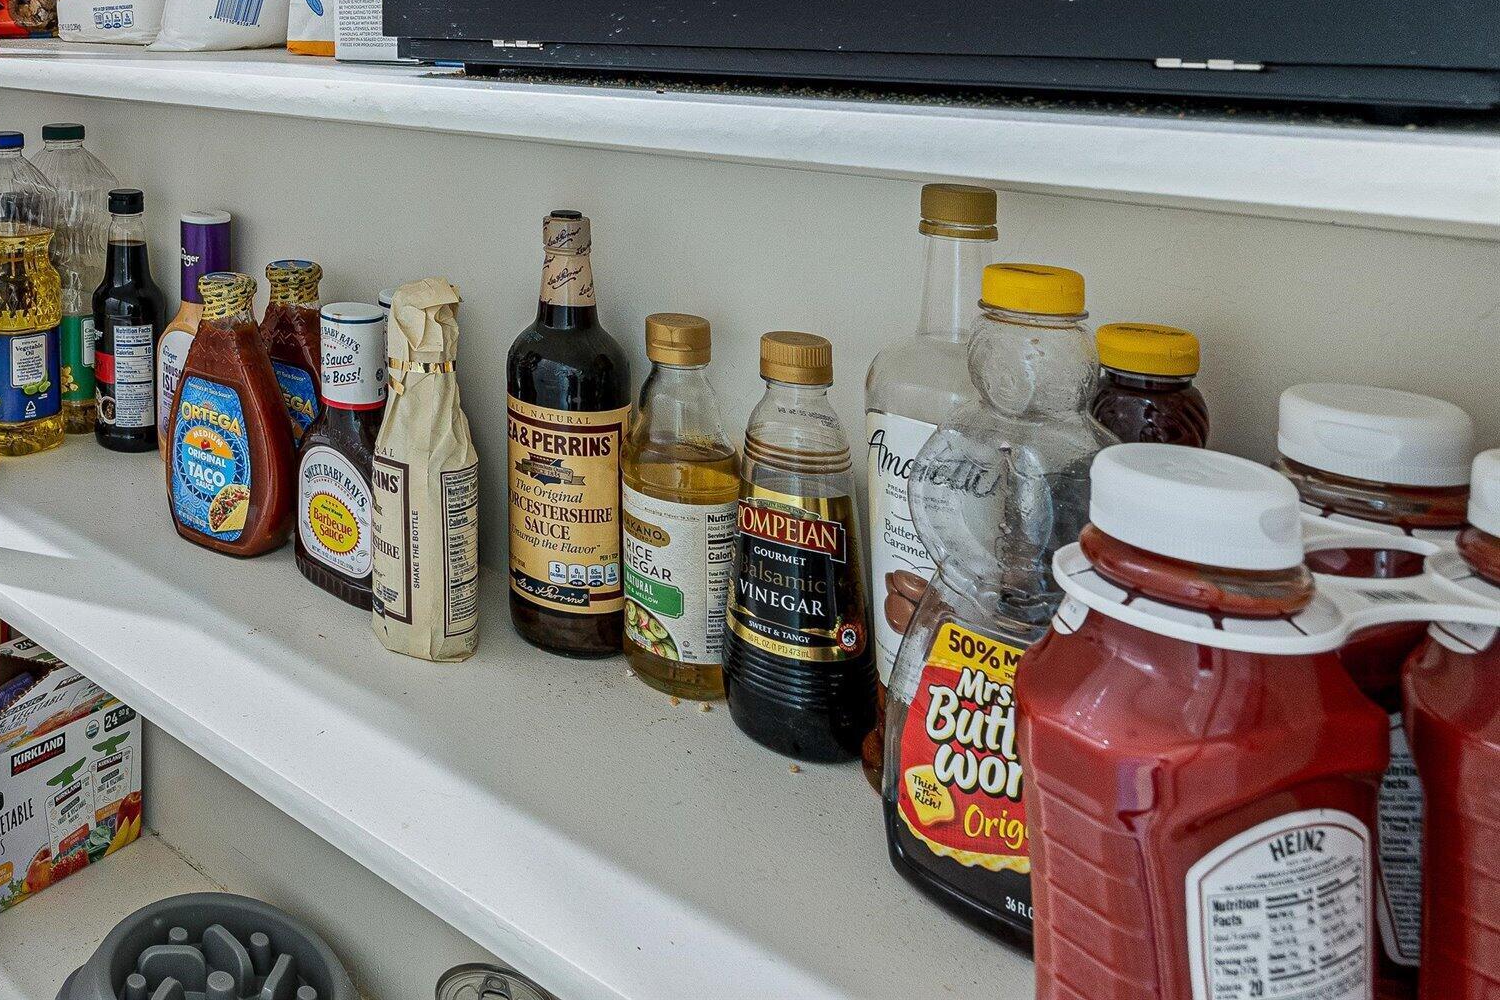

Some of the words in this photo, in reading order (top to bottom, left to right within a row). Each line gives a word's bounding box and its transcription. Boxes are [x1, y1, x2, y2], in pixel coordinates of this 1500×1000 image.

[15, 343, 43, 351] Vegetable
[324, 327, 338, 342] BABY
[339, 333, 360, 353] RAY'S
[326, 353, 353, 366] Sauce
[333, 368, 361, 383] Boss!
[181, 401, 242, 436] ORTEGA
[531, 410, 591, 425] NATURAL
[193, 431, 224, 447] MEDIUM
[188, 446, 226, 468] ORIGINAL
[188, 461, 226, 484] TACO
[195, 479, 215, 491] SAUCE
[304, 463, 323, 483] SWEET
[323, 464, 343, 483] BABY
[344, 477, 368, 508] RAY'S
[515, 478, 531, 492] The
[534, 488, 583, 504] Original
[510, 492, 612, 523] ORCESTERSHIRE
[313, 510, 353, 536] Barbecue
[319, 523, 344, 544] Sauce
[525, 516, 570, 540] SAUCE
[738, 504, 837, 550] POMPEIAN
[542, 536, 557, 550] the
[626, 538, 653, 562] RICE
[884, 532, 931, 560] Caramel
[754, 546, 806, 566] GOURMET
[555, 564, 560, 572] 5
[740, 555, 827, 593] Balsamic
[626, 572, 653, 596] NATURAL
[740, 578, 825, 617] VINEGAR
[749, 619, 772, 635] SWEET
[781, 632, 810, 644] TANGY
[789, 648, 801, 657] 473
[949, 628, 1000, 669] 50%
[957, 666, 1014, 707] Mrs.
[105, 714, 118, 729] 24
[927, 684, 1016, 760] Butt
[13, 734, 64, 767] KIRKLAND
[98, 753, 122, 768] KIRKLAND
[55, 780, 82, 802] KIRKLAND
[912, 773, 942, 797] Thick
[914, 790, 942, 810] Rich!
[1269, 830, 1326, 861] HEINZ
[1006, 896, 1017, 912] 36
[1018, 901, 1026, 918] FL
[1213, 898, 1260, 912] Nutrition
[1213, 913, 1242, 927] Facts
